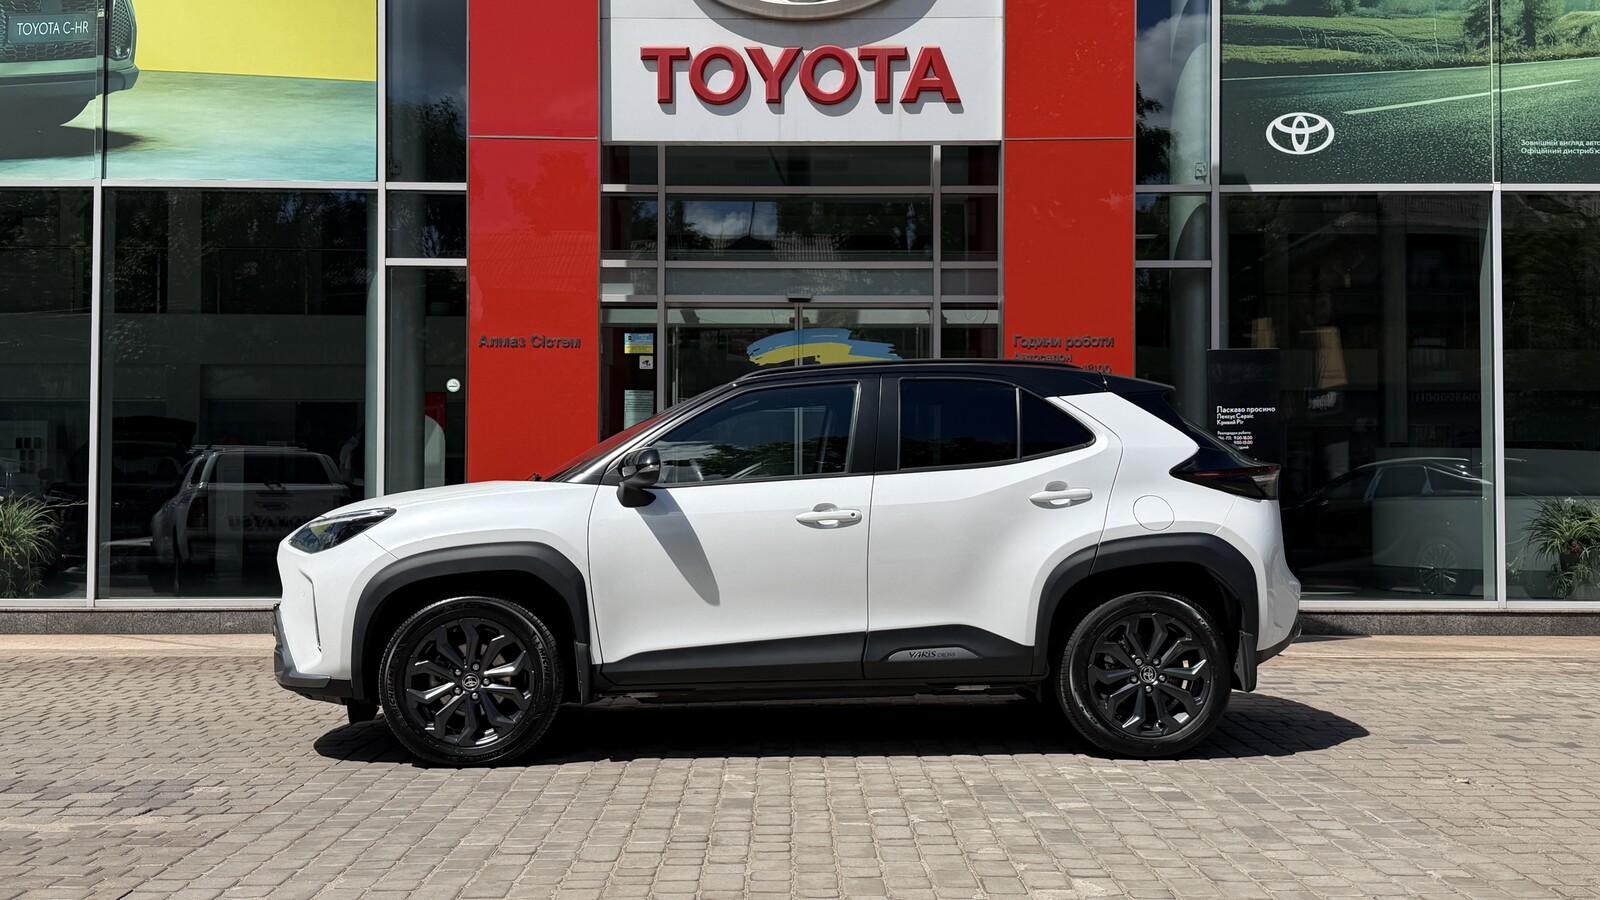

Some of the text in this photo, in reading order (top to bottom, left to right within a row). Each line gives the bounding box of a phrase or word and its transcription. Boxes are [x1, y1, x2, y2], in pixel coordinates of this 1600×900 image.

[17, 20, 89, 36] TOYOTA C-HR
[640, 45, 961, 105] TOYOTA
[1520, 138, 1559, 146] Зовнішній
[1520, 147, 1562, 155] Офіційний
[479, 335, 582, 349] Алмаз Сістем
[1013, 335, 1115, 351] Години роботи
